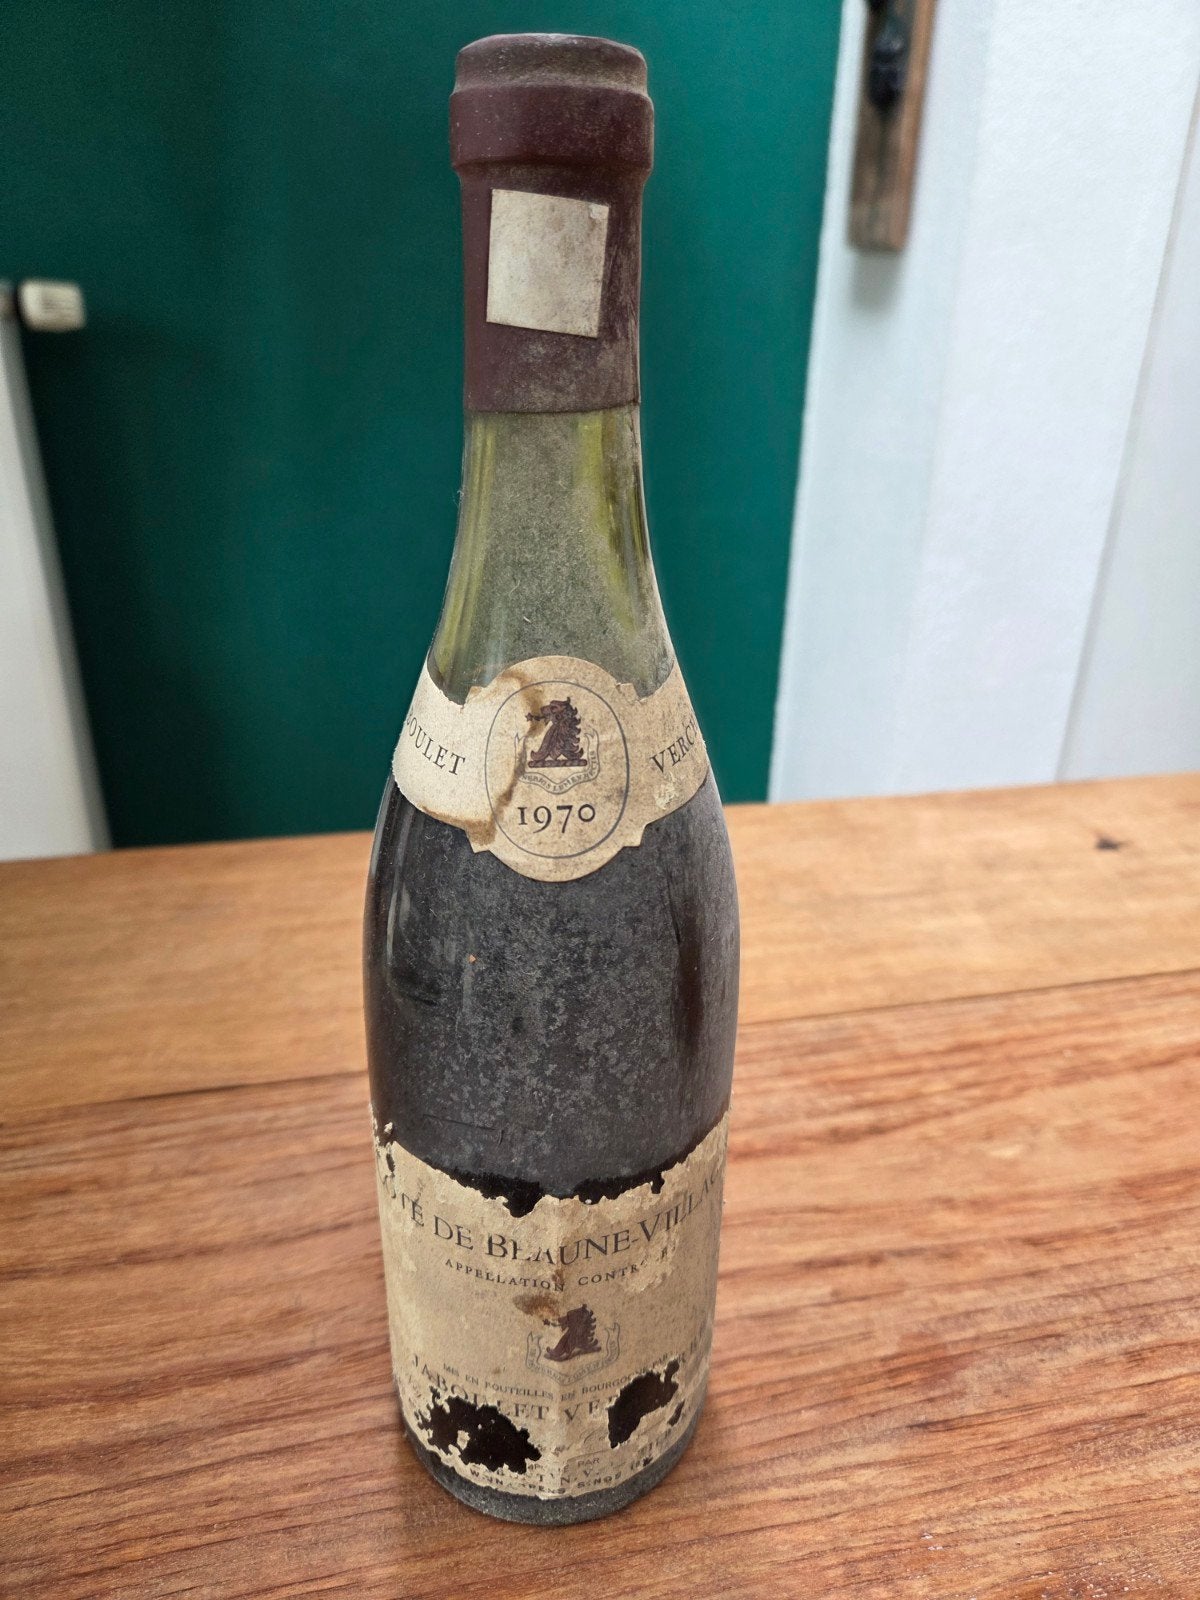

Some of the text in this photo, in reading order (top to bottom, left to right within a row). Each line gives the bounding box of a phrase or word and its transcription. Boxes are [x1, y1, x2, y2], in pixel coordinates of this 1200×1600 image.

[517, 803, 596, 834] 1970
[434, 1214, 474, 1250] DE
[445, 1258, 565, 1292] APPELLATION
